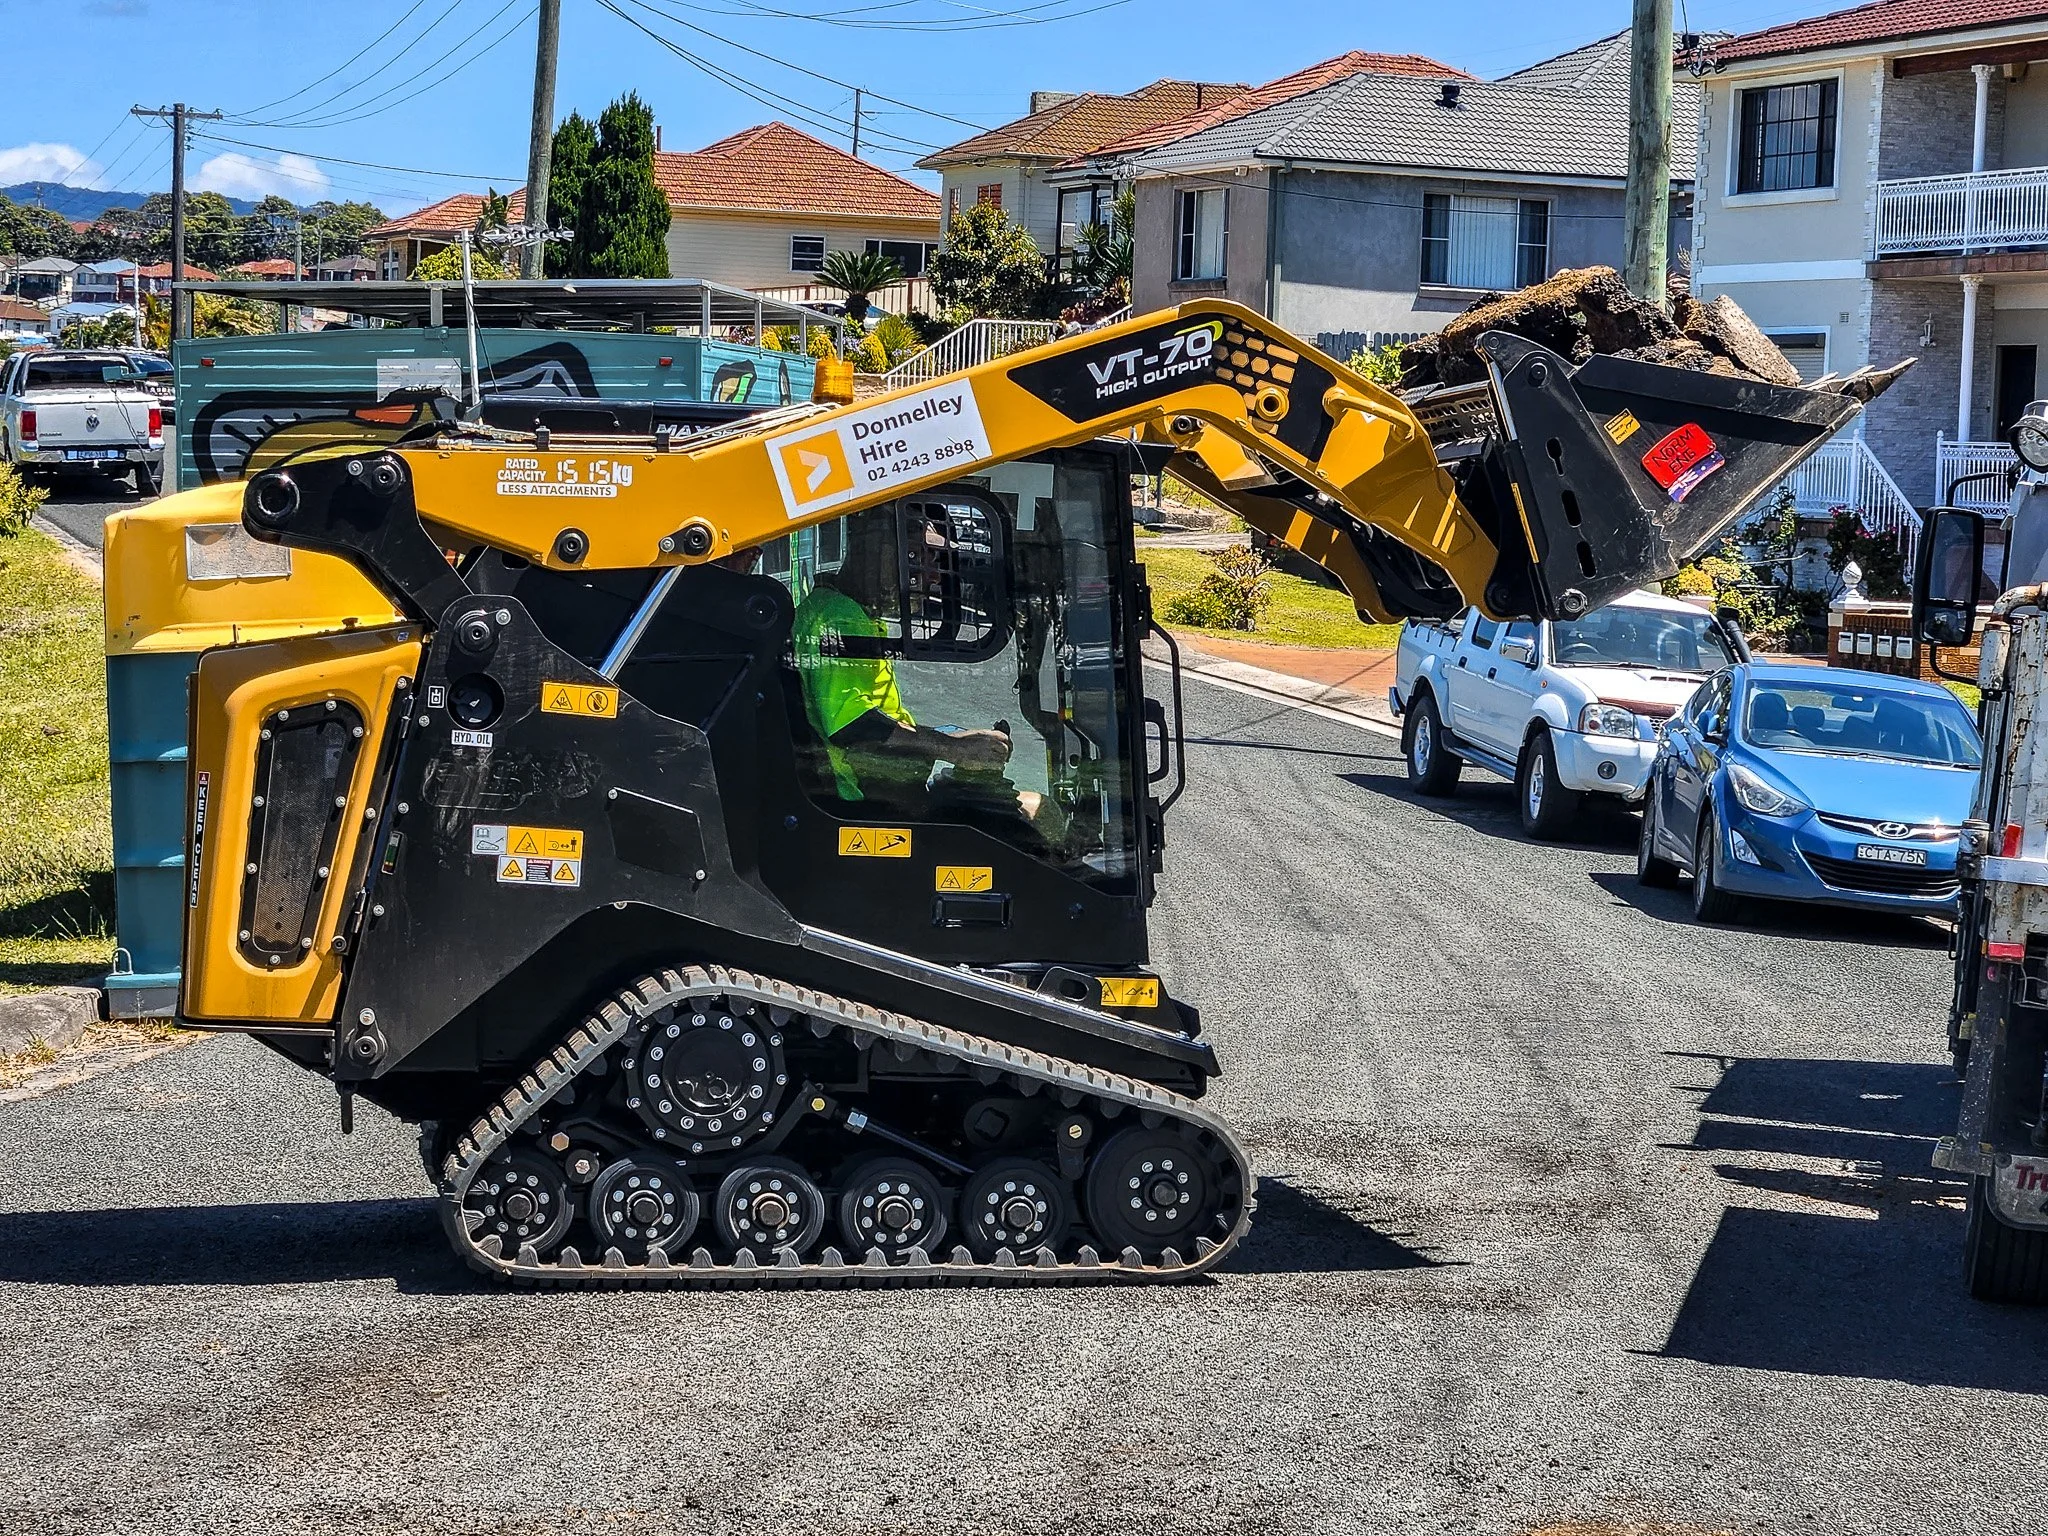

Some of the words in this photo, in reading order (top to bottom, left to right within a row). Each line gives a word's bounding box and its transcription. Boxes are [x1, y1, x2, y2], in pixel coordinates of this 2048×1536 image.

[1086, 329, 1213, 385] VT-70
[1096, 377, 1138, 399] HIGH
[1143, 354, 1212, 384] OUTPUT
[851, 395, 962, 441] Donnelley
[505, 458, 539, 470] RATED
[859, 438, 908, 465] Hire
[867, 466, 888, 481] 02
[891, 453, 931, 474] 4243
[934, 439, 975, 461] 8898
[497, 470, 547, 482] CAPACITY
[502, 484, 527, 494] LESS
[530, 485, 612, 496] ATTACHMENTS
[454, 731, 474, 744] HYD.
[476, 733, 491, 745] OIL
[196, 786, 206, 835] KEEP
[191, 843, 201, 904] CLEAR
